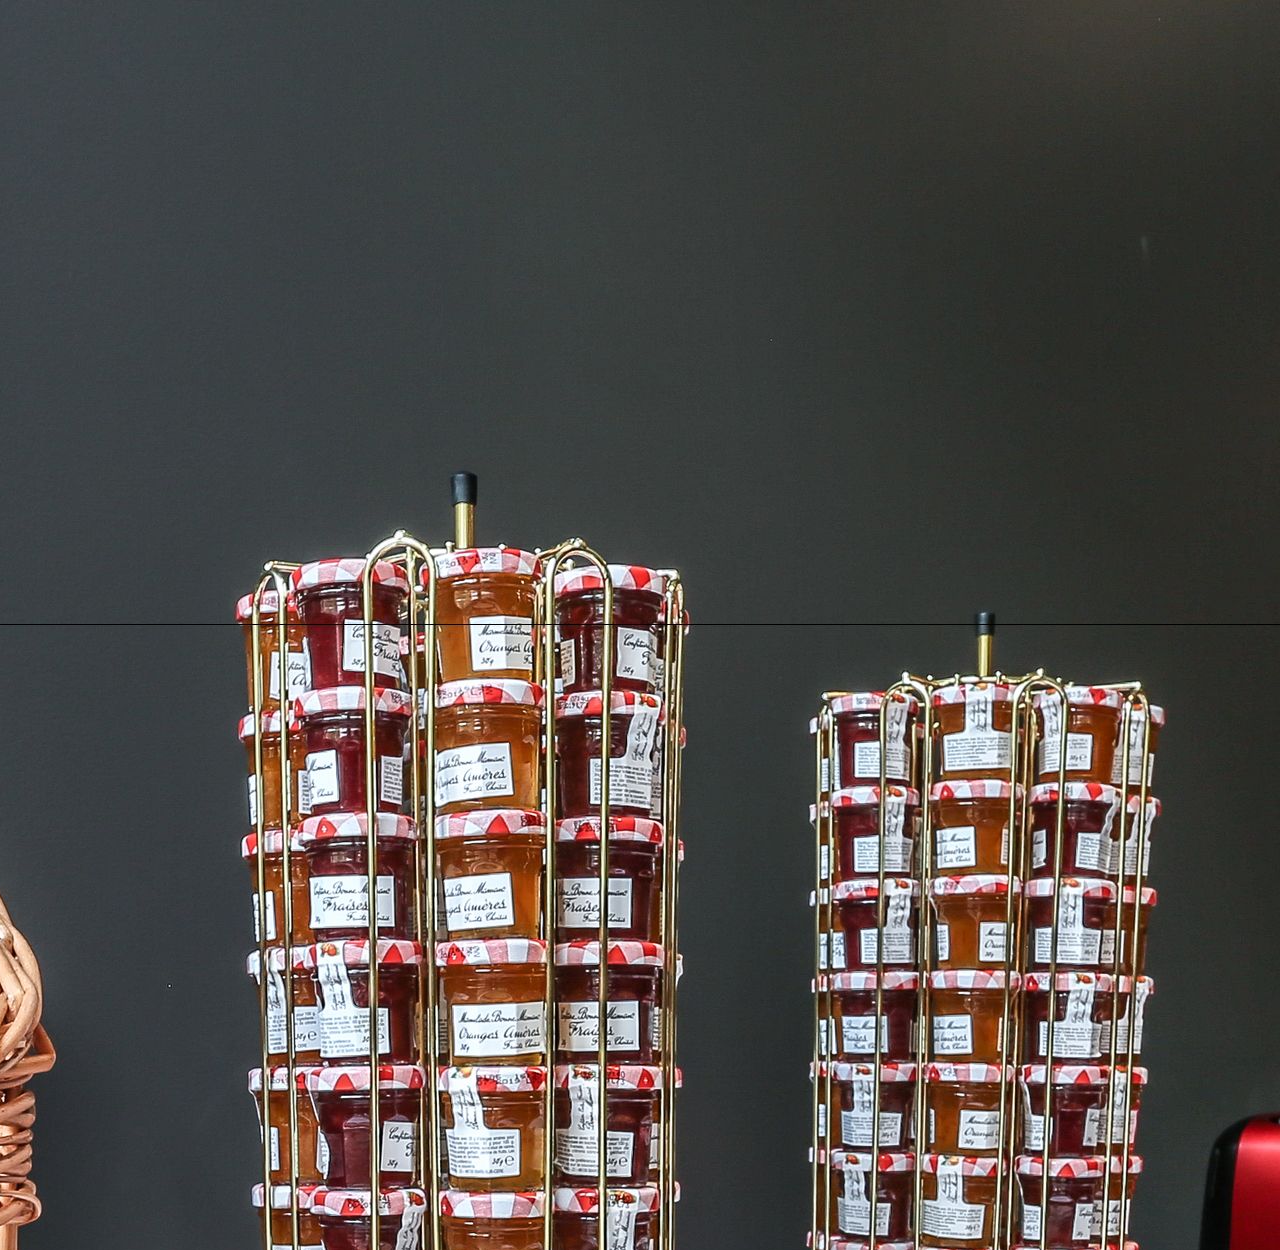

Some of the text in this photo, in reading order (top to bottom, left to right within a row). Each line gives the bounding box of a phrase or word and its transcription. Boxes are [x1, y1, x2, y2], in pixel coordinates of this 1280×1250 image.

[479, 641, 521, 656] Oranges
[332, 881, 357, 896] Bonne
[322, 896, 370, 912] Fraises
[562, 897, 601, 913] Fraise
[458, 1027, 499, 1043] Oranges
